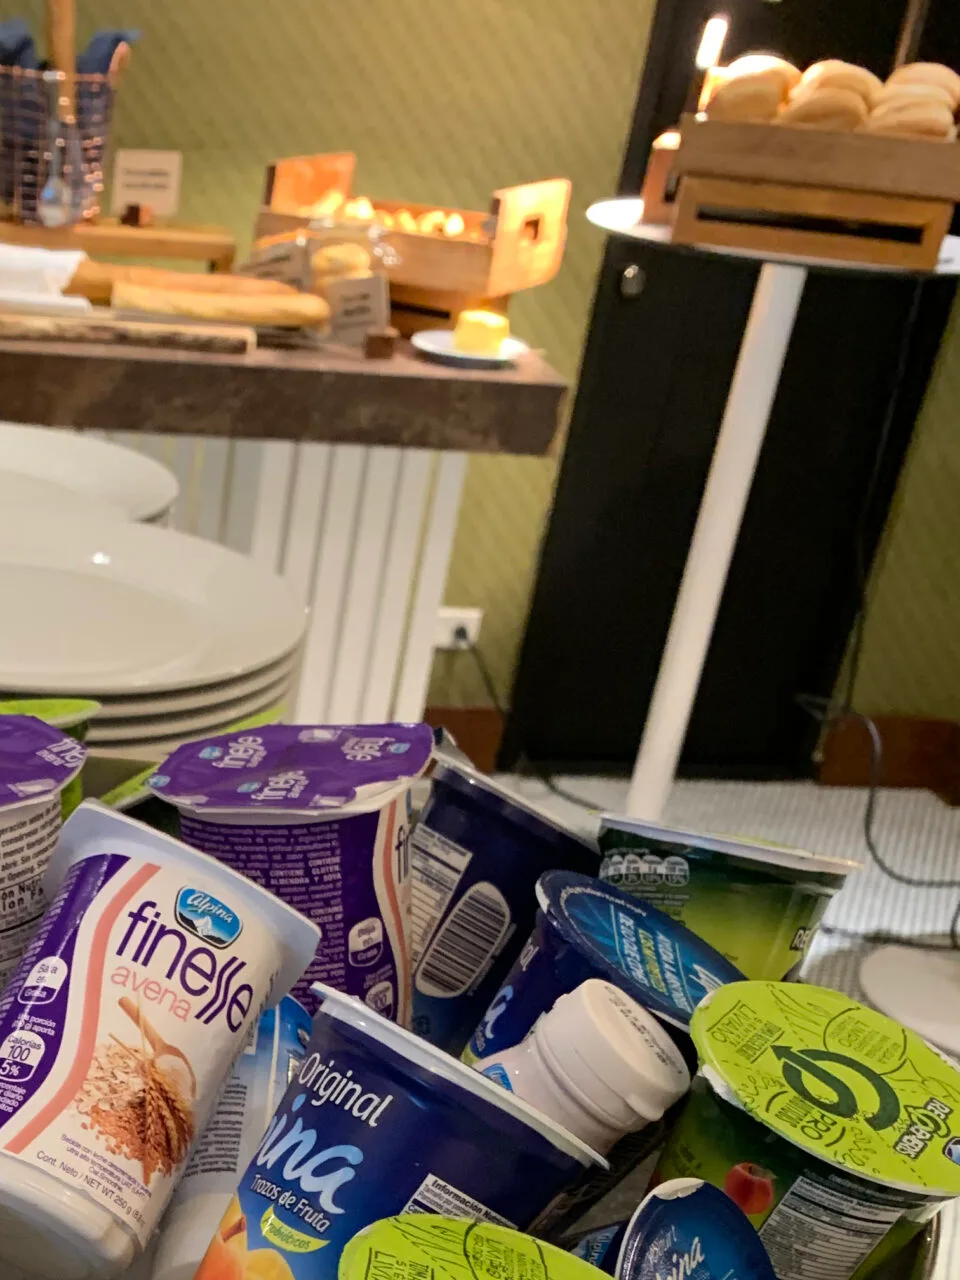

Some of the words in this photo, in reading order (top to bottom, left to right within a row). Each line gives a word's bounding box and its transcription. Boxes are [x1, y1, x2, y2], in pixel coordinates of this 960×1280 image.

[186, 890, 234, 925] Alpina
[116, 900, 255, 1033] finesse
[110, 962, 194, 1023] avena
[29, 1014, 57, 1028] porción
[32, 1023, 55, 1037] aporta
[711, 1003, 757, 1043] LIVIANO
[8, 1044, 31, 1063] 100
[297, 1051, 394, 1129] Original
[800, 1110, 838, 1141] PRO
[894, 1096, 952, 1159] REGENERIS
[36, 1150, 58, 1167] Cont.
[58, 1161, 79, 1179] Neto
[83, 1175, 102, 1190] NET
[101, 1185, 116, 1199] WT
[113, 1195, 128, 1209] 250
[431, 1178, 483, 1215] Información
[250, 1173, 279, 1200] Trozos
[279, 1191, 297, 1209] de
[294, 1198, 331, 1234] Fruta
